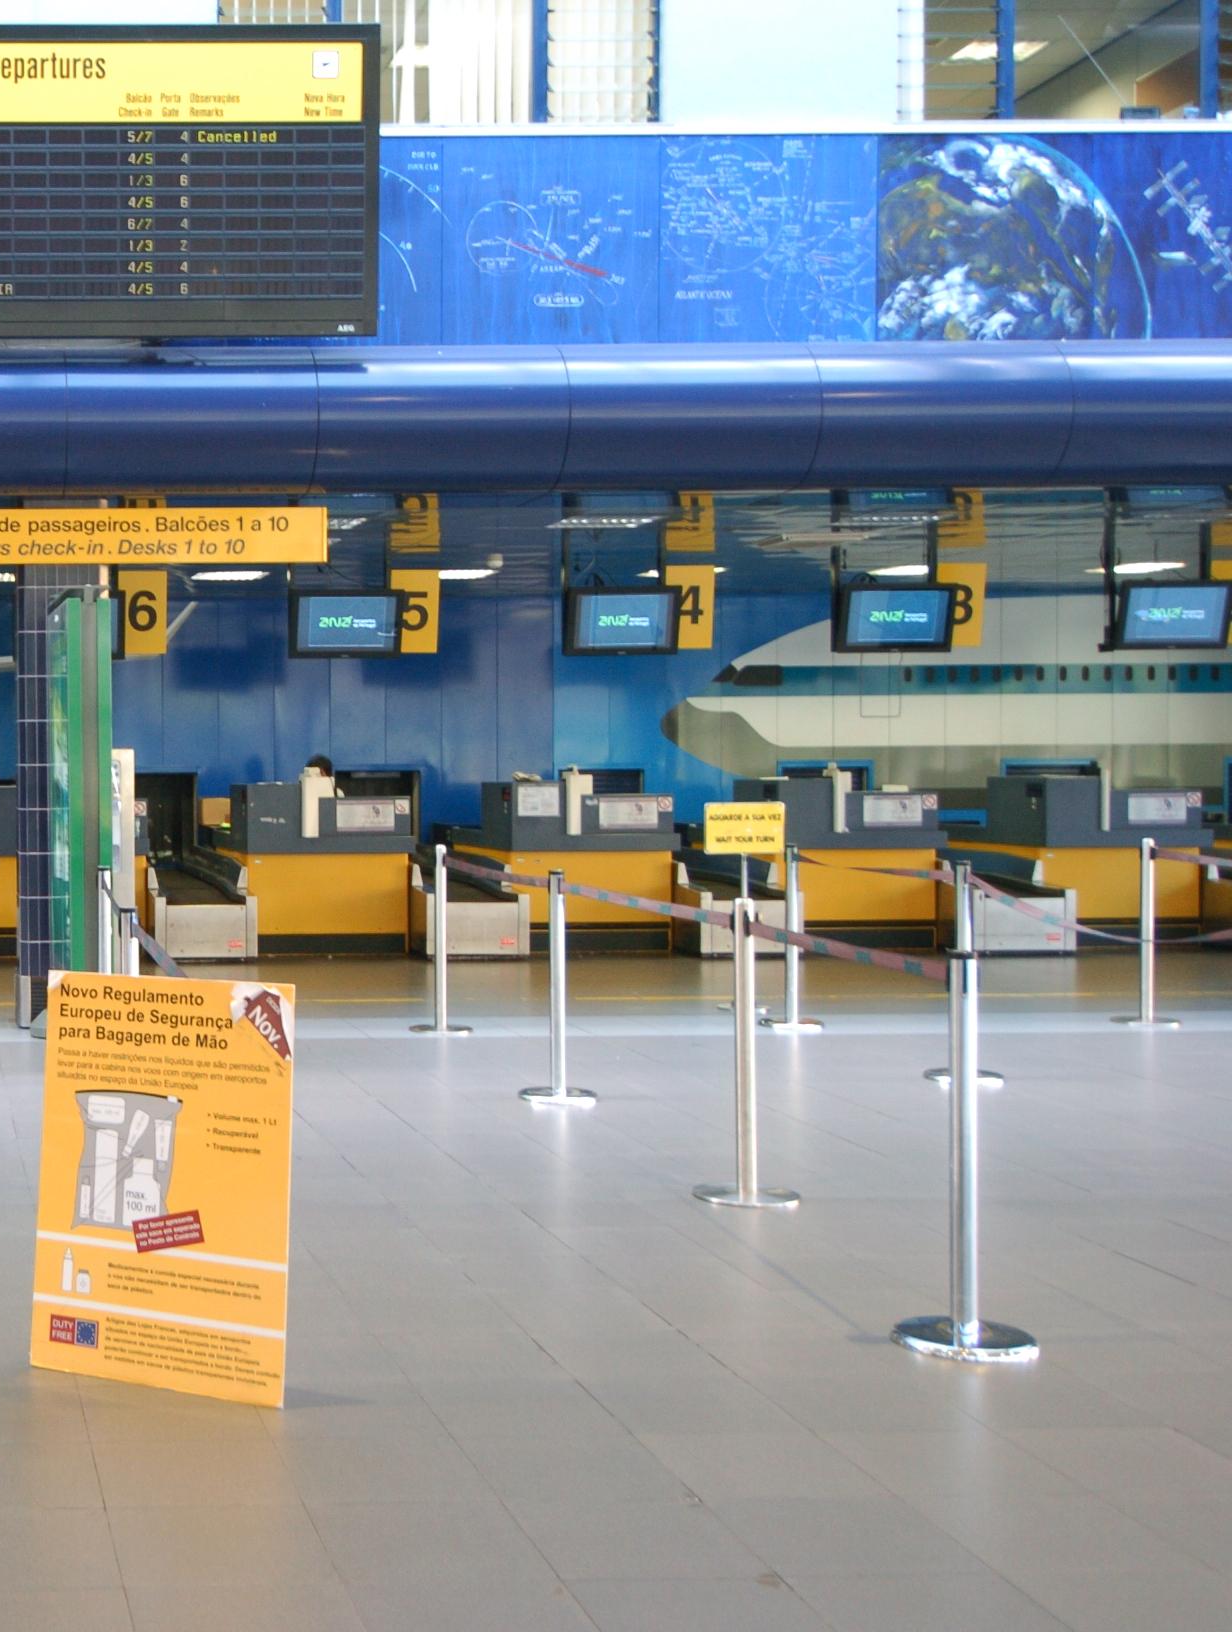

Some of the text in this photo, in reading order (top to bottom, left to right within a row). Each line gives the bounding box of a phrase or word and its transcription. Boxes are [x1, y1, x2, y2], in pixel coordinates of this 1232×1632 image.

[160, 93, 181, 103] Porta
[304, 93, 345, 103] Nova Hora
[118, 107, 153, 117] Check-in
[161, 107, 179, 117] Gate
[189, 107, 224, 117] Remarks
[304, 107, 343, 117] New Time
[127, 131, 153, 143] 5/7
[180, 131, 189, 143] 4
[198, 131, 277, 143] Cancelled
[128, 153, 153, 165] 4/5
[181, 153, 188, 165] 4
[129, 175, 153, 187] 1/3
[180, 175, 188, 187] 6
[128, 197, 153, 209] 4/5
[180, 197, 188, 209] 6
[128, 218, 152, 231] 6/7
[180, 218, 188, 231] 4
[129, 240, 153, 252] 1/3
[128, 262, 153, 274] 4/5
[180, 262, 188, 274] 4
[128, 284, 153, 296] 4/5
[156, 515, 228, 532] Balcões
[236, 516, 244, 532] 1
[250, 520, 261, 532] a
[268, 516, 288, 532] 10
[118, 538, 178, 555] Desks
[184, 538, 192, 554] 1
[199, 539, 217, 554] to
[225, 537, 245, 554] 10
[127, 590, 157, 631] 6
[401, 591, 428, 630] 5
[678, 585, 703, 624] 4
[60, 984, 204, 1007] Novo Regulamento
[60, 1004, 233, 1031] Europeu de Segurança
[248, 1005, 281, 1049] Nov.
[58, 1026, 228, 1050] para Bagagem de Mão
[196, 1060, 211, 1068] que
[127, 1201, 157, 1213] 100 ml
[53, 1319, 73, 1329] DUTY
[52, 1330, 73, 1341] FREE
